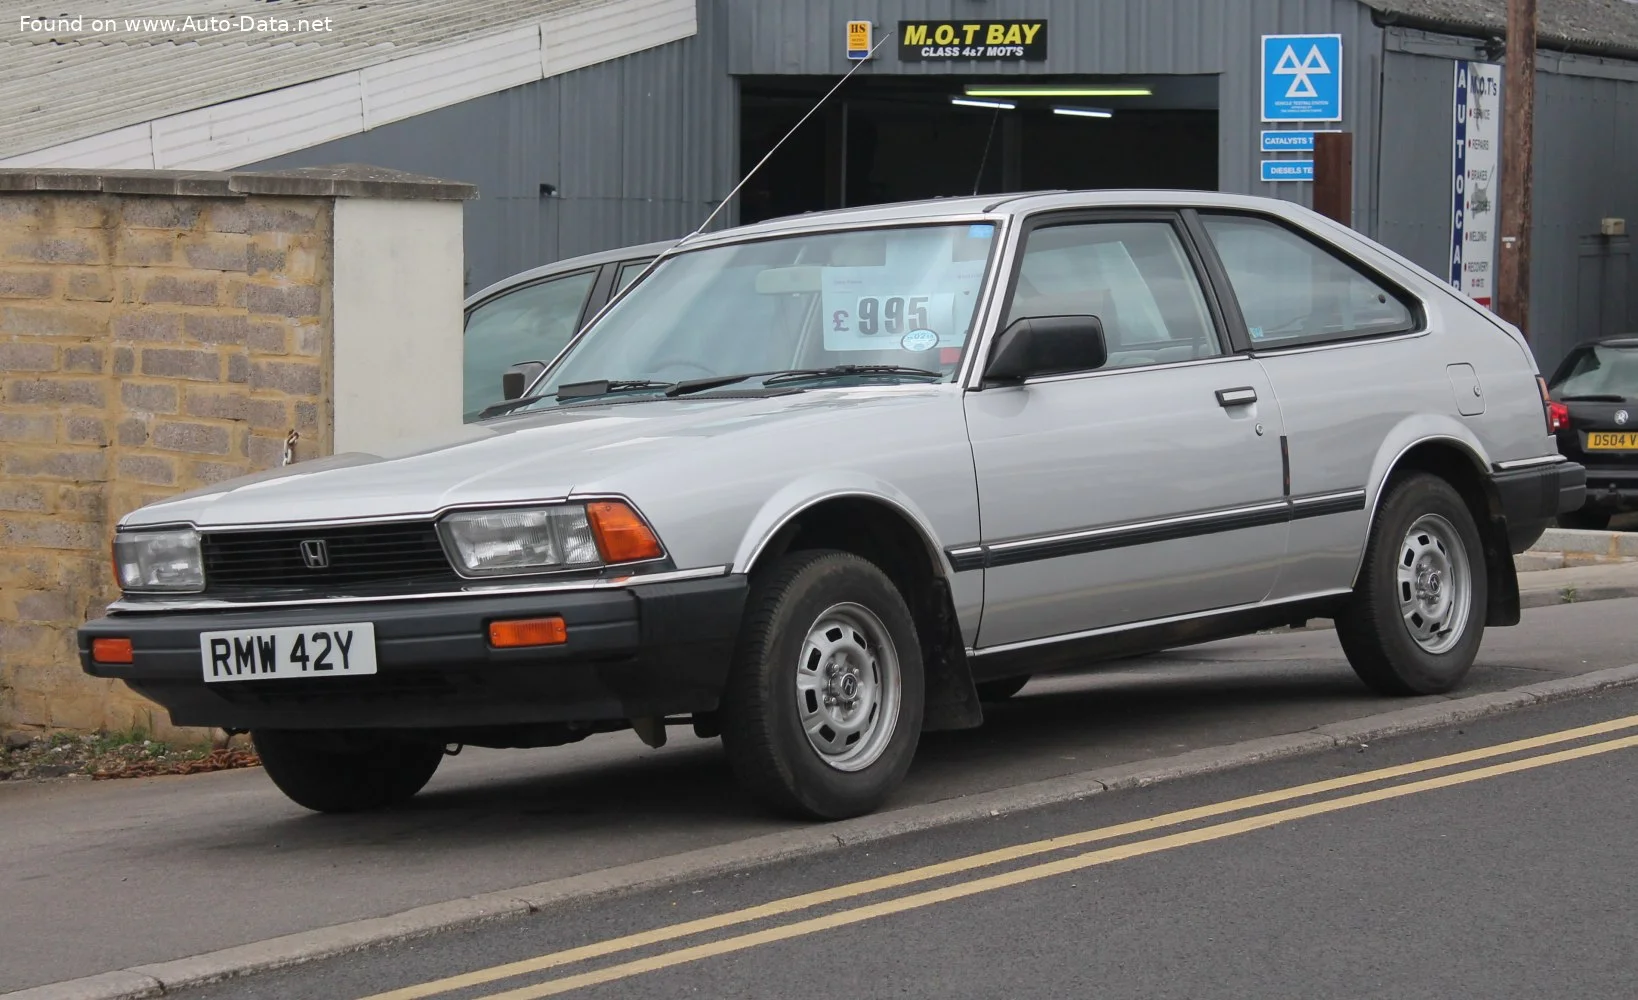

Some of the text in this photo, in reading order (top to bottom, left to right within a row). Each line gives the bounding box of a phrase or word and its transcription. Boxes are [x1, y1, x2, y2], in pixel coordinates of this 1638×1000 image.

[904, 23, 1042, 45] M.O.T BAY
[921, 46, 1024, 57] CLASS 4&7 MOT'S
[1264, 137, 1308, 145] CATALYSTS
[1270, 166, 1302, 175] DIESELS
[1471, 169, 1488, 181] BRAKES
[1467, 261, 1489, 273] RECOVERY
[858, 297, 929, 335] 995
[1594, 434, 1625, 446] DS04
[210, 630, 354, 676] RMW 42Y
